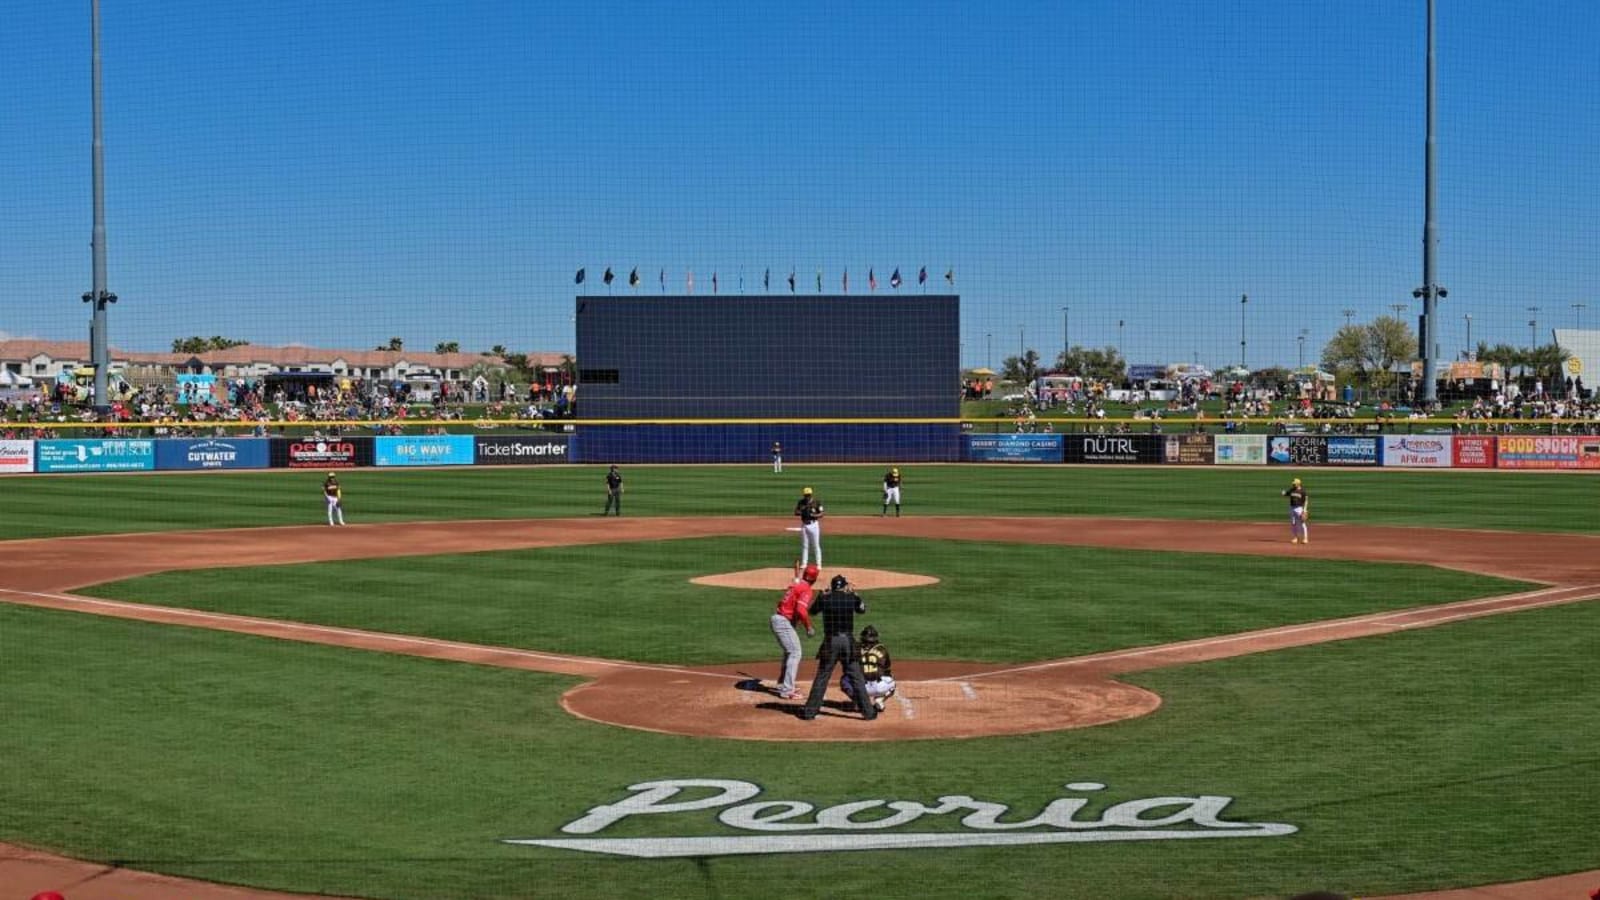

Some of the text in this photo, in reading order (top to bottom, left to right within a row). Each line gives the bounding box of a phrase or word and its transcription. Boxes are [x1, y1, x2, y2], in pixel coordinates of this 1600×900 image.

[1290, 437, 1326, 446] PEORIA
[1500, 438, 1579, 454] FOODSTOCK
[396, 444, 452, 456] BIG WAVE
[477, 442, 567, 456] TicketSmarter
[188, 452, 236, 461] CUTWATER
[1290, 454, 1320, 464] PLACE
[1401, 455, 1438, 464] AFW.com
[560, 778, 1298, 834] Peoria
